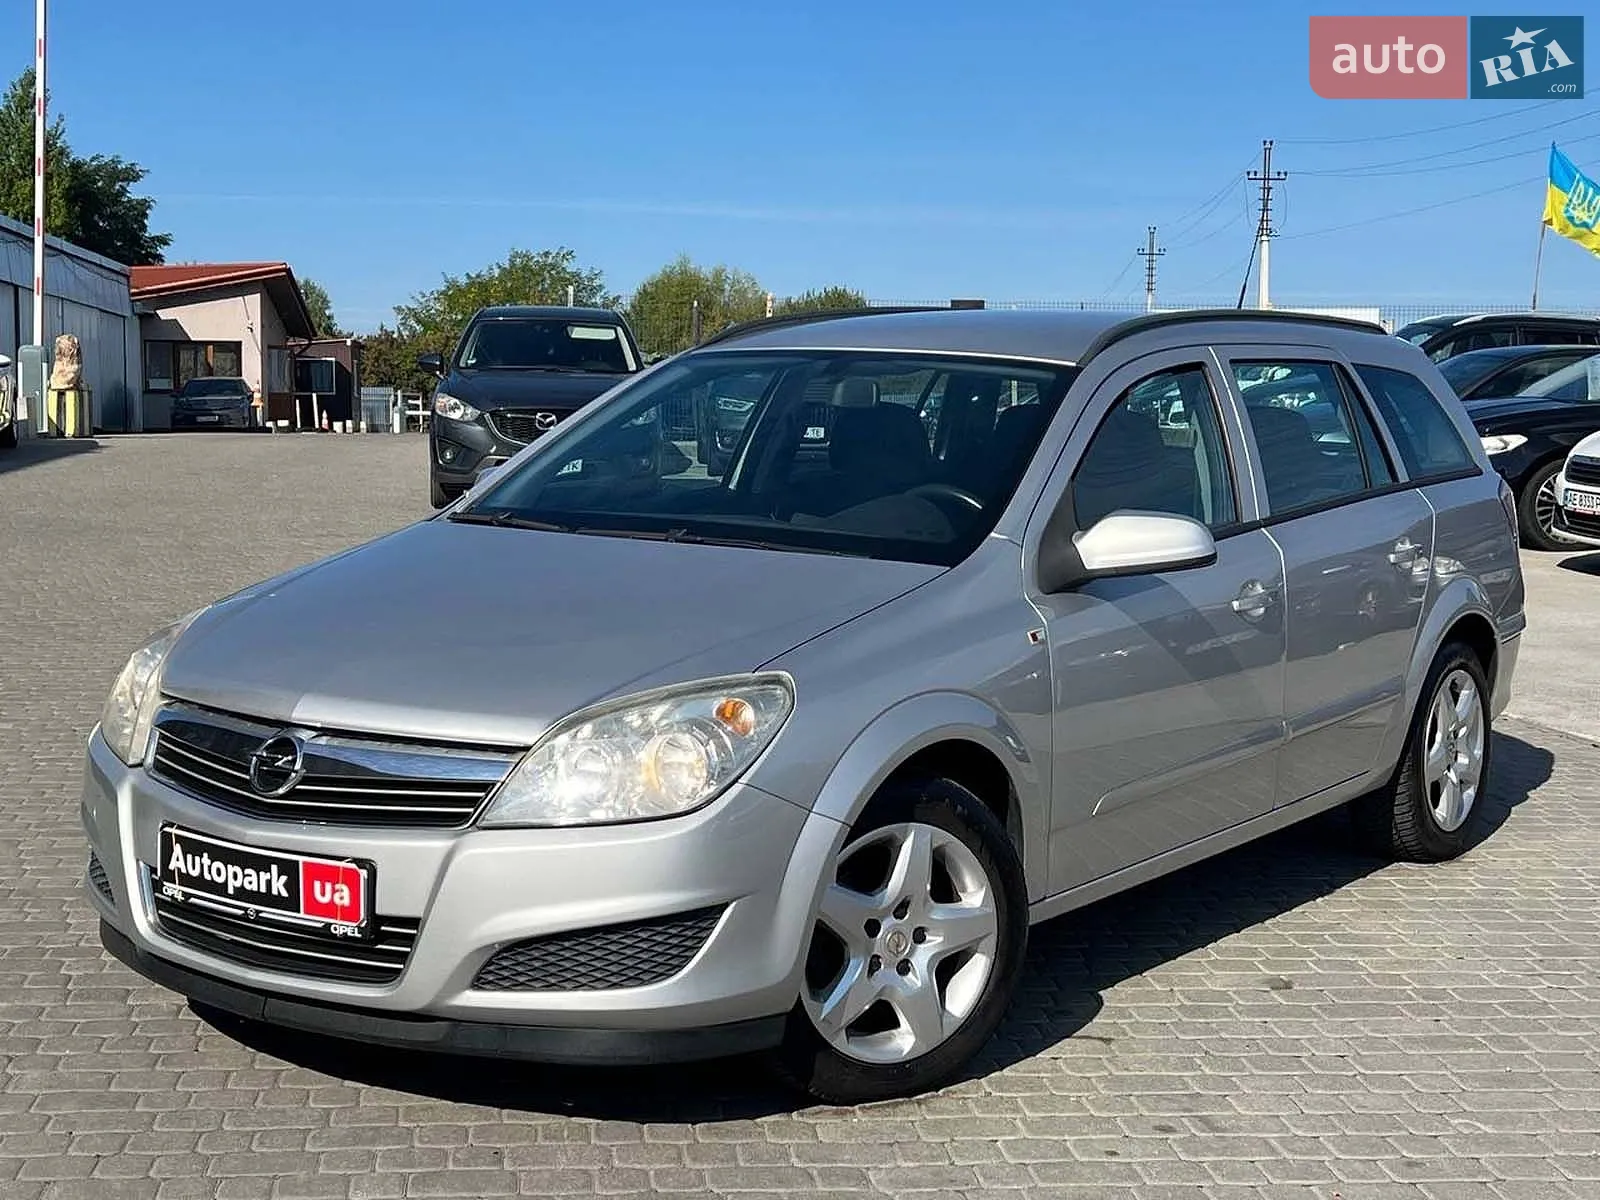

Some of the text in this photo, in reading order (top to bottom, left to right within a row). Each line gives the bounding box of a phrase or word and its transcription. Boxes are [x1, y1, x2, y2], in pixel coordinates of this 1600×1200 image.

[168, 843, 350, 907] Autopark ua
[330, 924, 362, 938] OPEL
